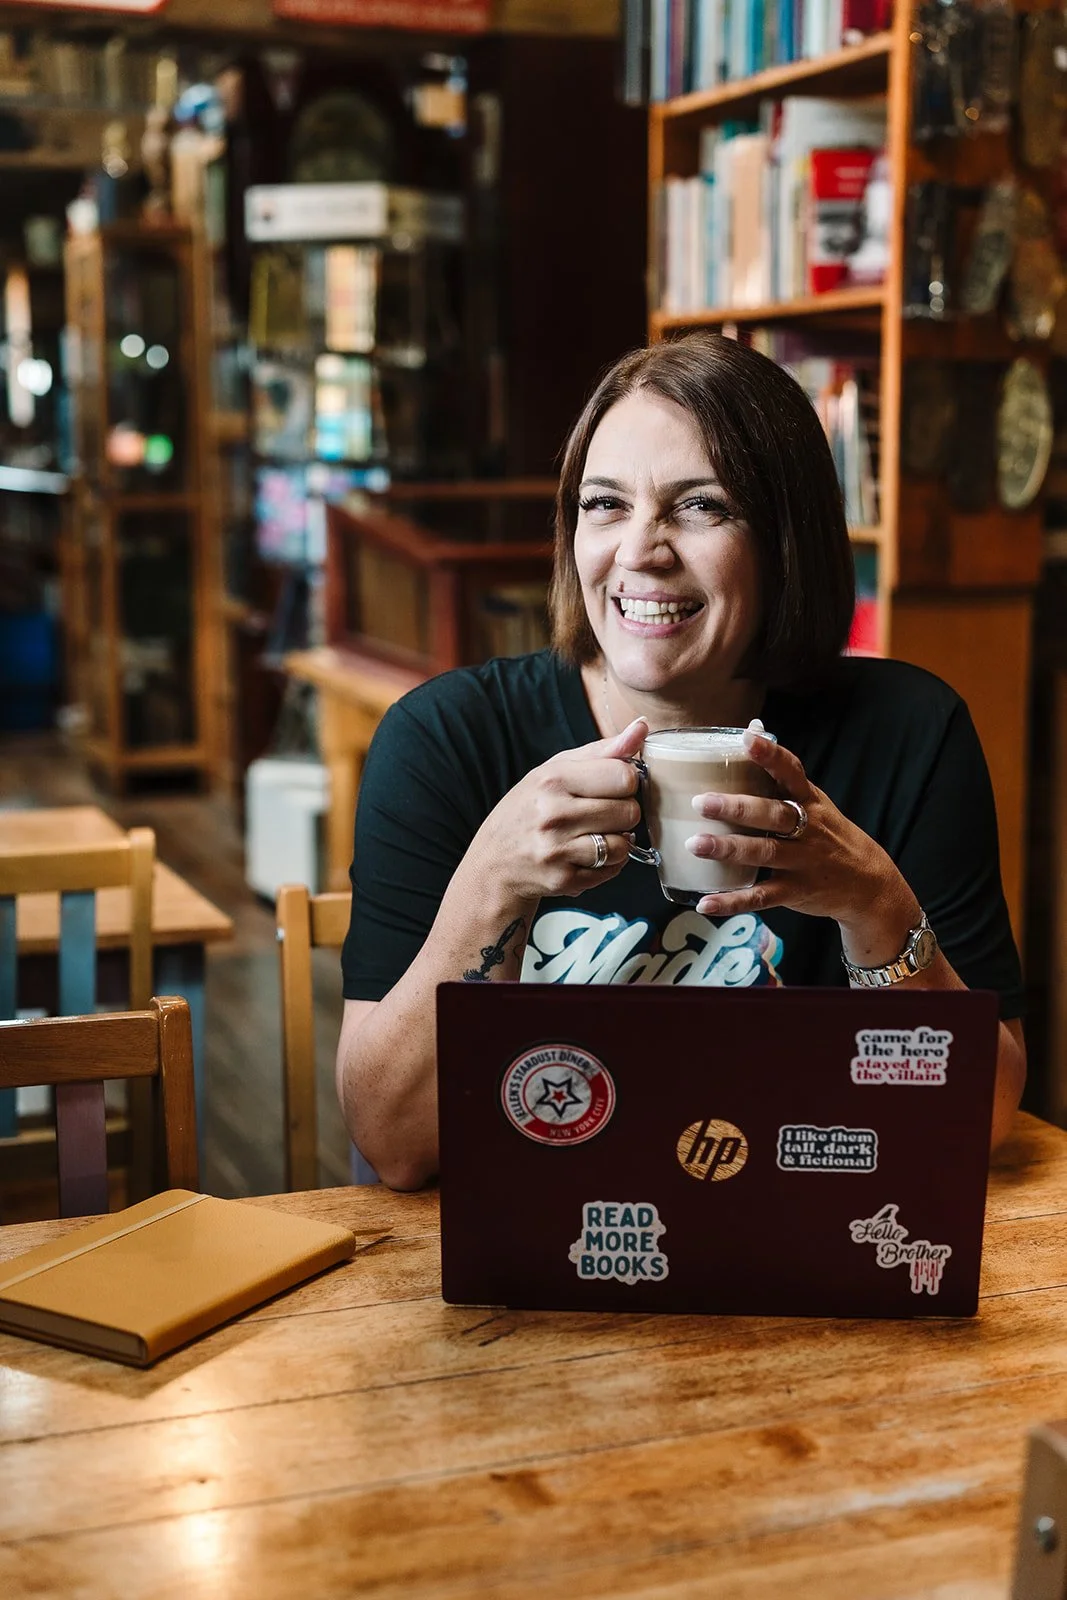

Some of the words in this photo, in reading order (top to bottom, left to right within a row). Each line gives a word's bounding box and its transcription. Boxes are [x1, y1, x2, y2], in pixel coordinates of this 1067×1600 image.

[861, 1033, 911, 1044] came
[919, 1031, 948, 1044] for
[864, 1044, 894, 1056] the
[901, 1044, 945, 1057] hero
[512, 1051, 557, 1082] STARDUST
[559, 1050, 590, 1070] DINER
[856, 1058, 910, 1072] stayed
[917, 1058, 942, 1069] for
[856, 1070, 882, 1080] the
[888, 1070, 941, 1081] villain
[574, 1115, 597, 1135] YORK
[786, 1131, 792, 1141] I
[795, 1130, 827, 1142] like
[830, 1132, 873, 1143] them
[823, 1143, 873, 1155] dark
[783, 1154, 795, 1165] &
[799, 1154, 873, 1167] fictional
[587, 1206, 654, 1228] READ
[854, 1219, 905, 1240] Hello
[585, 1231, 655, 1252] MORE
[880, 1242, 948, 1265] Brother
[581, 1254, 665, 1277] BOOKS
